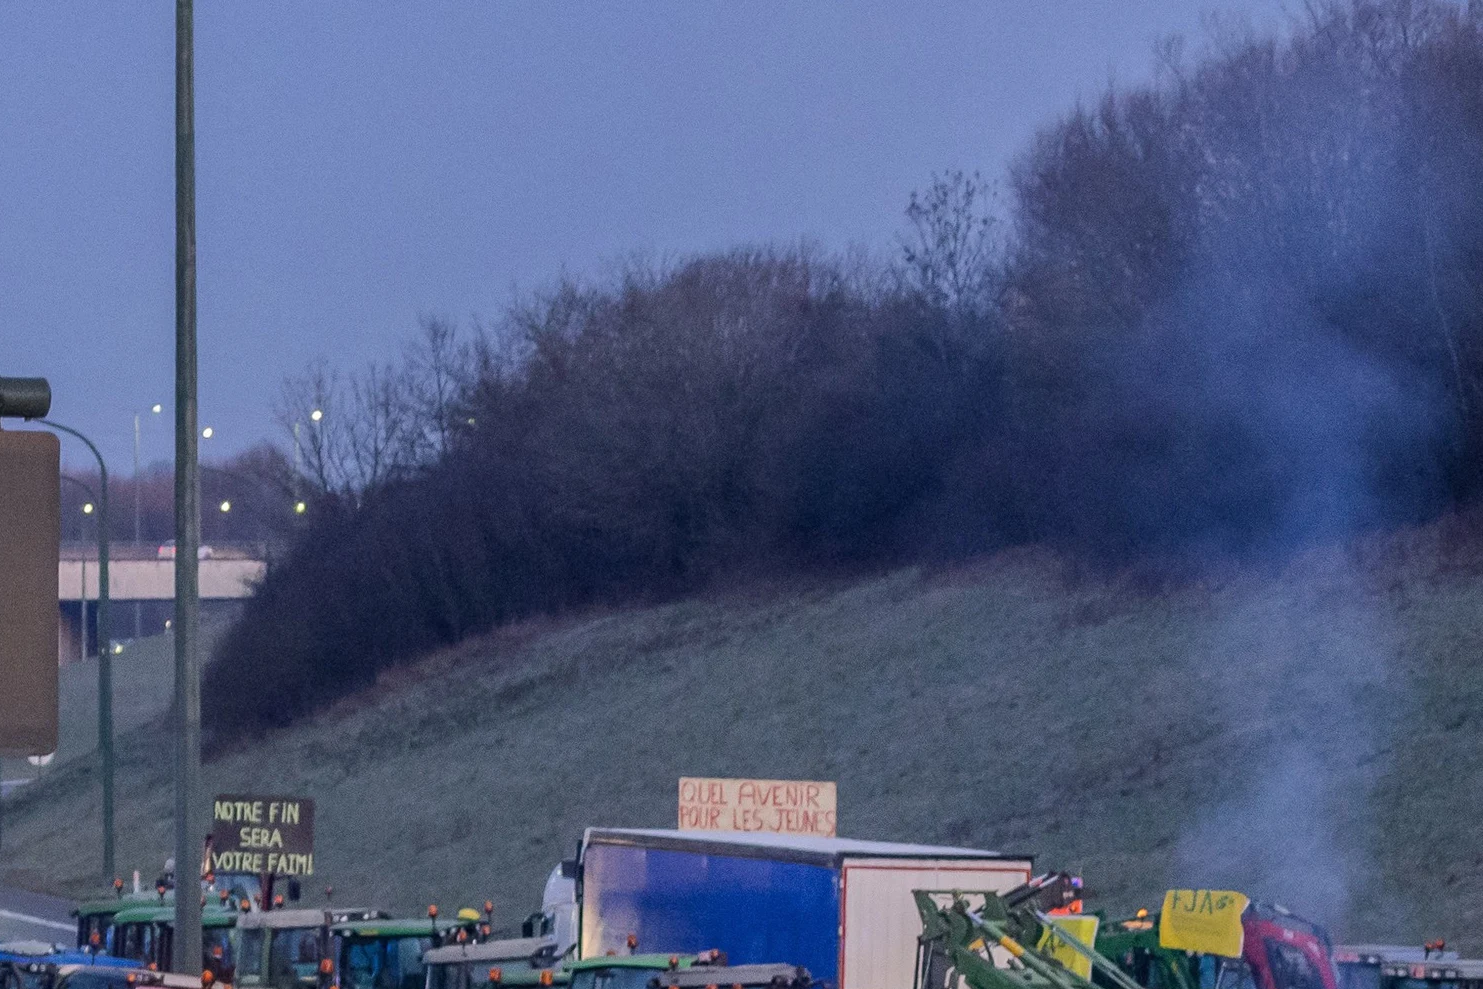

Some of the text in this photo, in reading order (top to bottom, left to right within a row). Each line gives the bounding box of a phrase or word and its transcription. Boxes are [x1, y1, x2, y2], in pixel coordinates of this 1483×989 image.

[681, 781, 728, 805] QUEL
[214, 801, 300, 824] NOTRE FIN
[679, 805, 836, 838] POUR LES JEUNES
[239, 827, 283, 848] SERA
[212, 851, 263, 873] VOTRE
